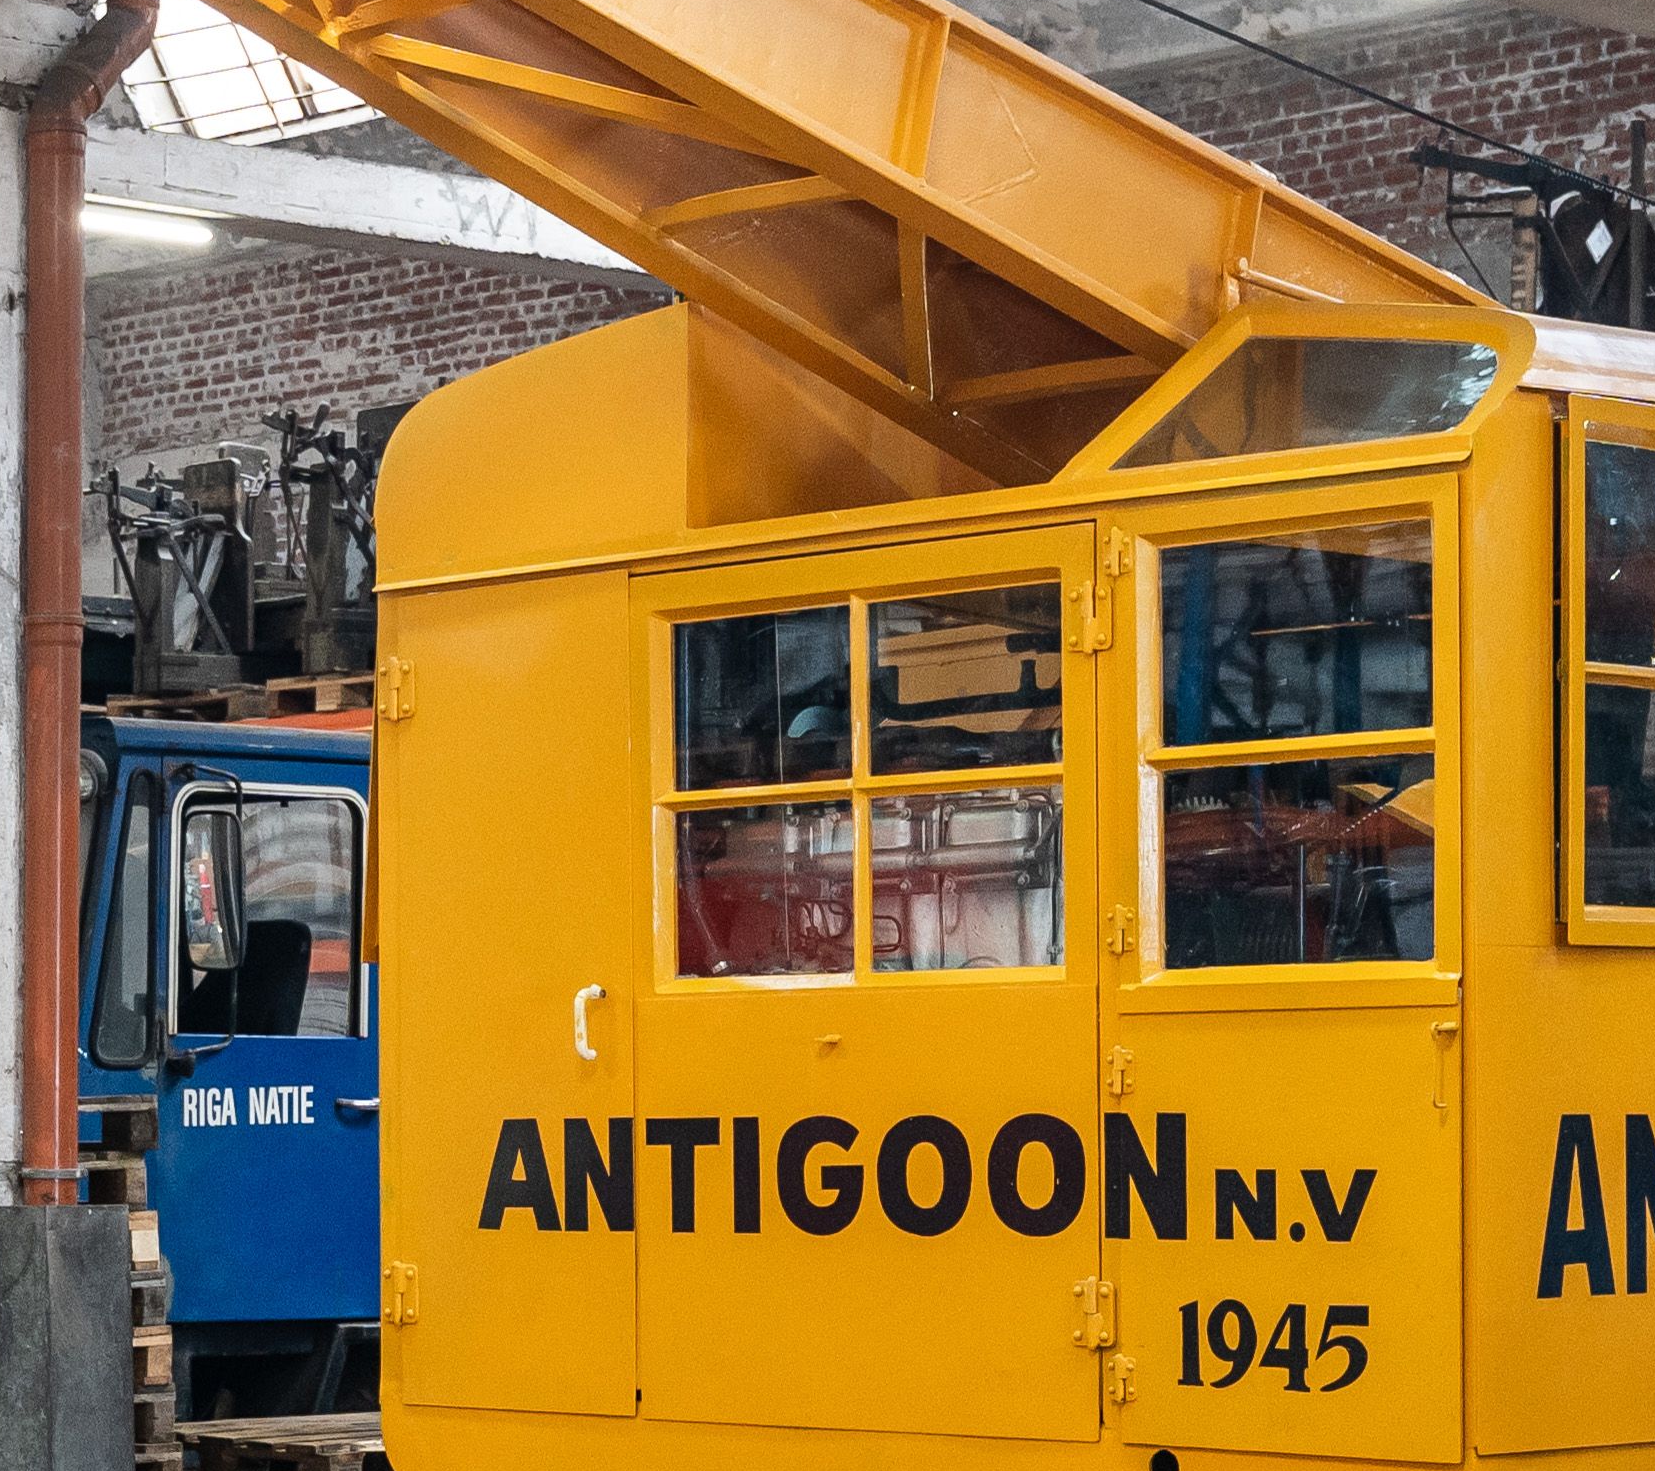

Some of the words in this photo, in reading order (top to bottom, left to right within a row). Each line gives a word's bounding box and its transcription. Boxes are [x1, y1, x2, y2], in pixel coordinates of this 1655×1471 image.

[183, 1087, 238, 1127] RIGA
[249, 1085, 315, 1125] NATIE
[478, 1113, 1187, 1237] ANTIGOON
[1215, 1169, 1377, 1242] N.V
[1177, 1299, 1370, 1392] 1945
